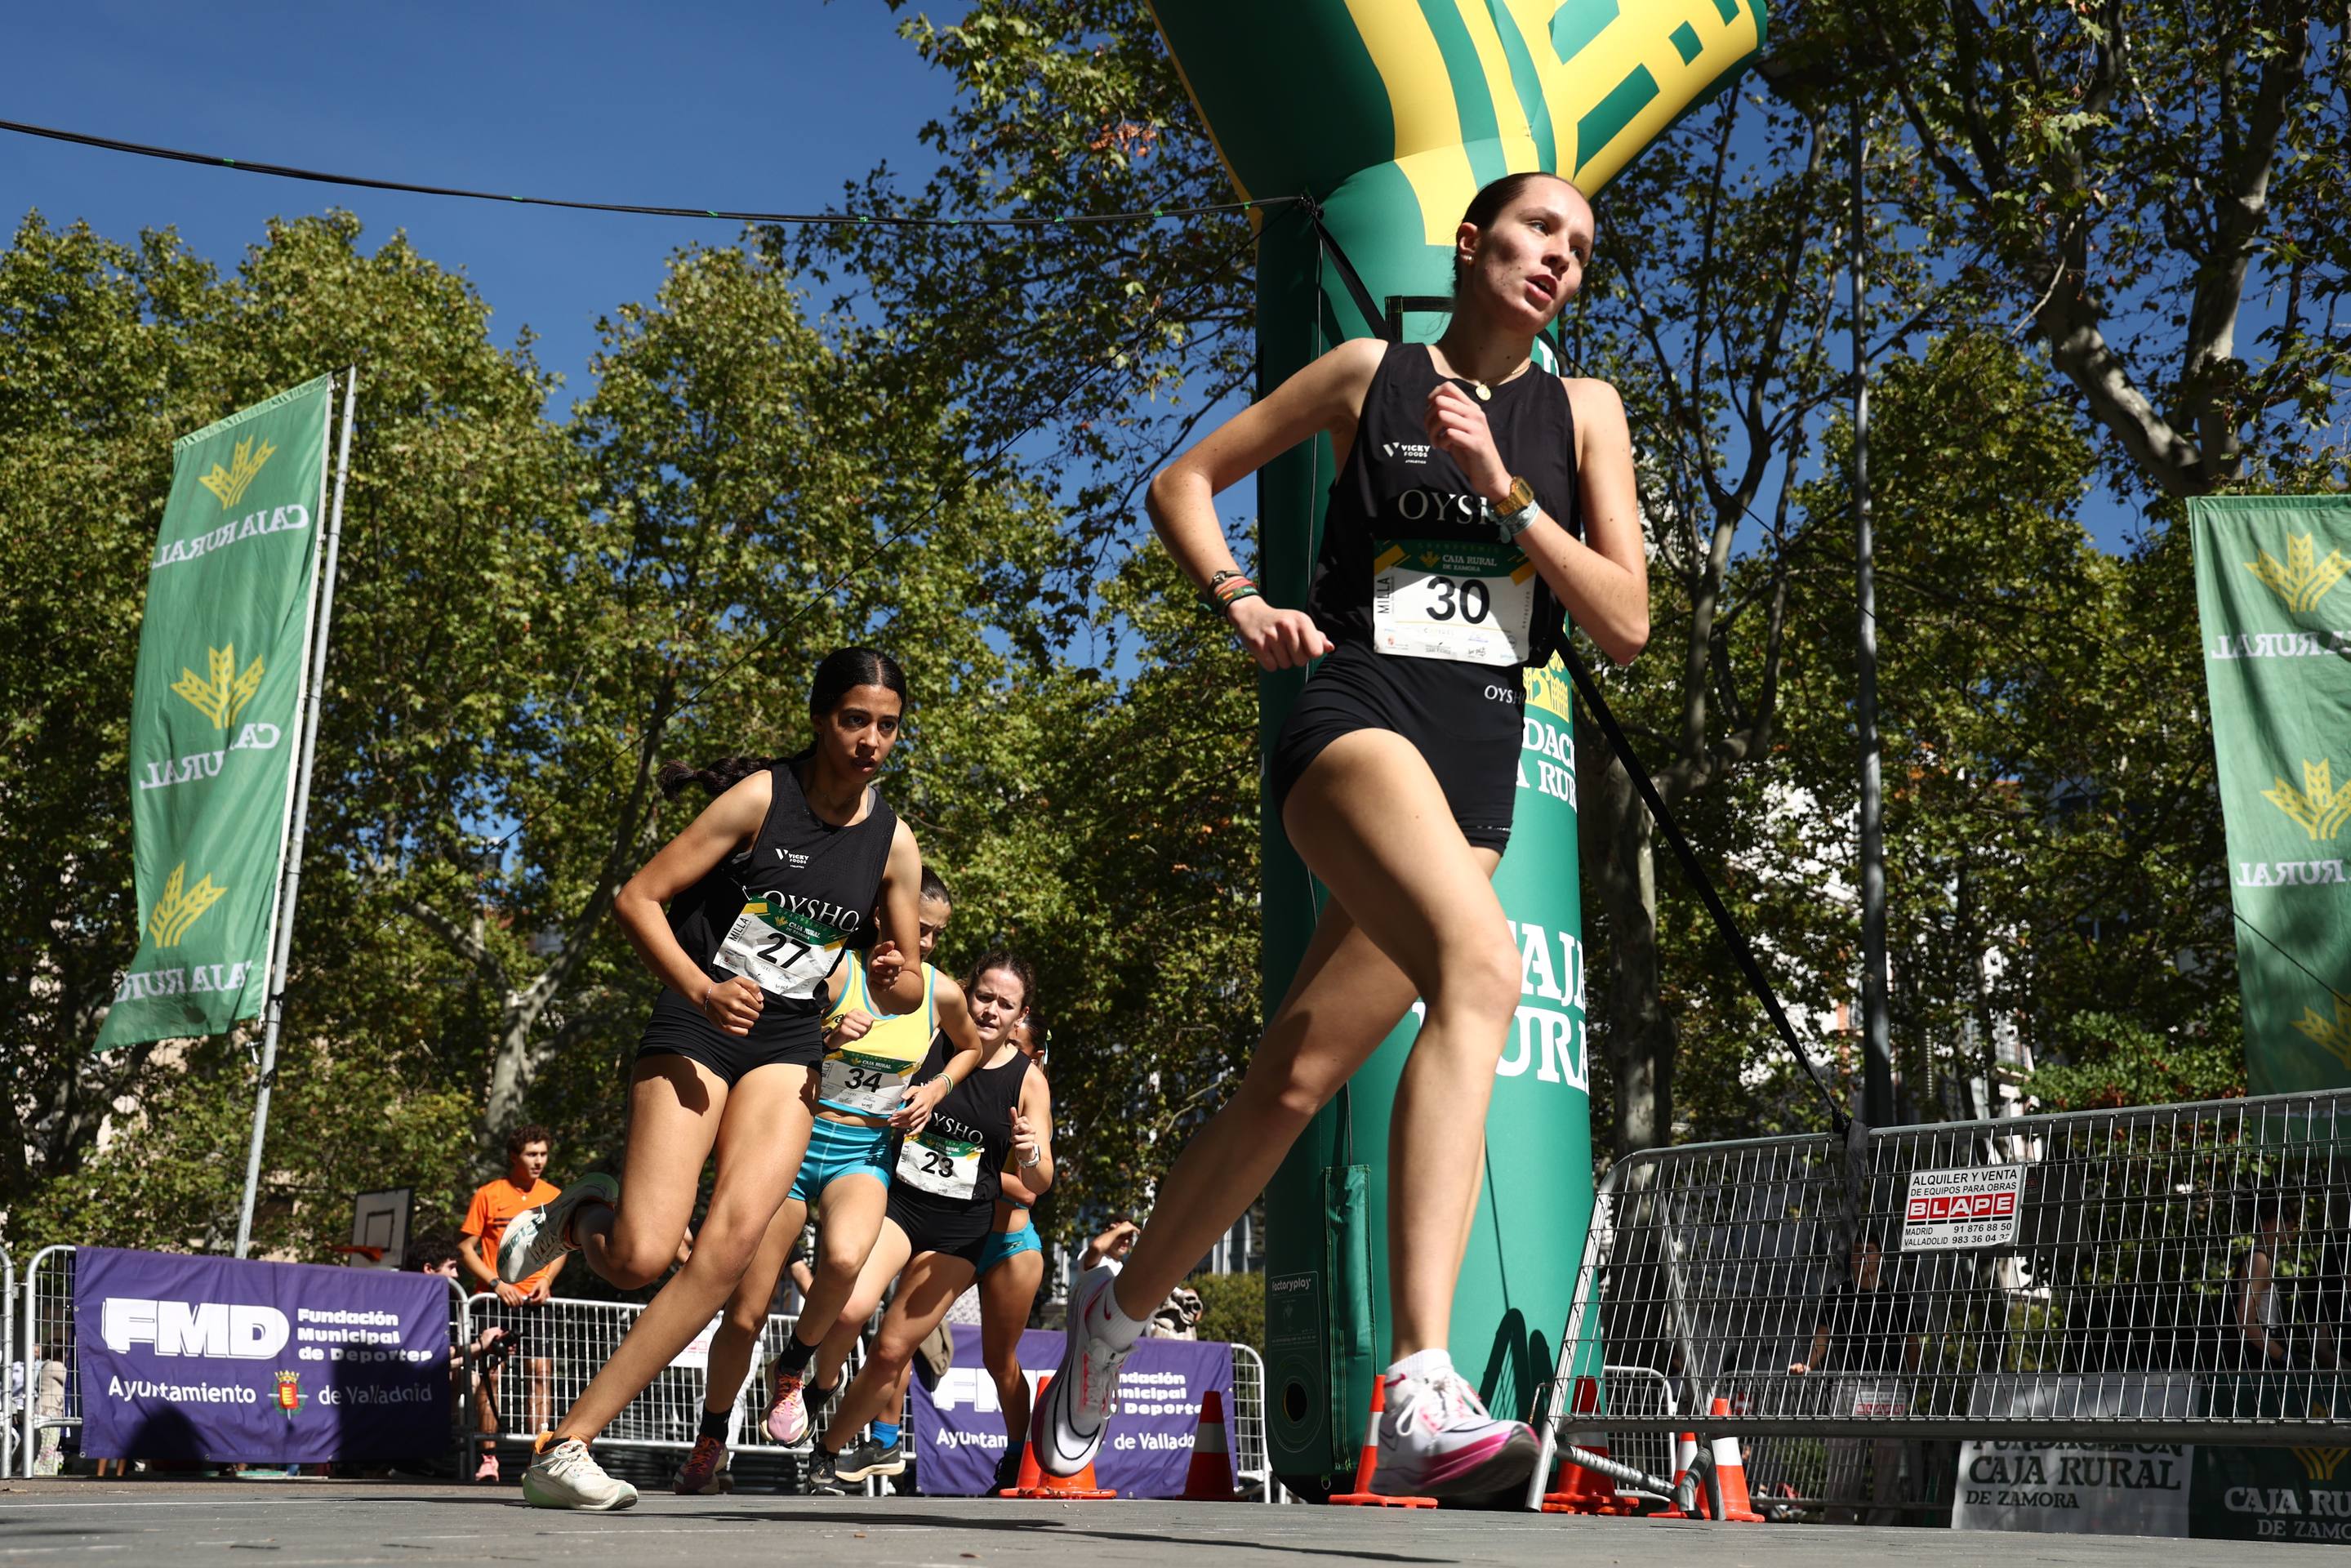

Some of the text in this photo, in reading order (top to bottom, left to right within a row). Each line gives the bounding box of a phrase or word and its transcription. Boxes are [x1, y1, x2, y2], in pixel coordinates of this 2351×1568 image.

[1442, 555, 1498, 567] CAJA RURAL
[1378, 576, 1391, 614] MILLA
[1426, 576, 1490, 625] 30
[788, 853, 809, 861] VICKY
[759, 890, 860, 933] OYSHO
[728, 917, 750, 942] MILLA
[788, 921, 804, 933] CAJA
[756, 932, 812, 969] 27
[1521, 923, 1586, 1015] AJA
[844, 1067, 883, 1094] 34
[933, 1111, 984, 1144] YSHO
[920, 1151, 954, 1178] 23
[1912, 1169, 2017, 1187] ALQUILER Y VENTA
[1911, 1188, 1921, 1196] DE
[1924, 1186, 1961, 1196] EQUIPOS
[1962, 1185, 1984, 1193] PARA
[1987, 1182, 2017, 1192] OBRAS
[1909, 1196, 2012, 1216] BLAPE
[1905, 1223, 2012, 1236] MADRID 91 876 88 50
[1904, 1236, 1948, 1246] VALLADOLID
[1952, 1236, 1969, 1244] 983
[1970, 1235, 1983, 1243] 36
[1985, 1234, 1997, 1242] 04
[1271, 1278, 1310, 1292] factoryplay
[297, 1307, 399, 1326] Fundación
[101, 1297, 291, 1360] FMD
[297, 1327, 401, 1345] Municipal
[298, 1346, 433, 1364] de Deportes
[1119, 1372, 1186, 1385] ndación
[108, 1374, 256, 1404] Ayuntamiento
[318, 1384, 341, 1405] de
[1117, 1387, 1187, 1401] nicipal
[1124, 1402, 1203, 1416] Deporte
[1114, 1432, 1137, 1450] de
[1138, 1432, 1196, 1450] Vallado
[1969, 1455, 2182, 1490] CAJA RURAL
[1965, 1490, 2081, 1509] DE ZAMORA
[2224, 1486, 2351, 1517] CAJA RU
[2256, 1519, 2351, 1539] DE ZAMO
